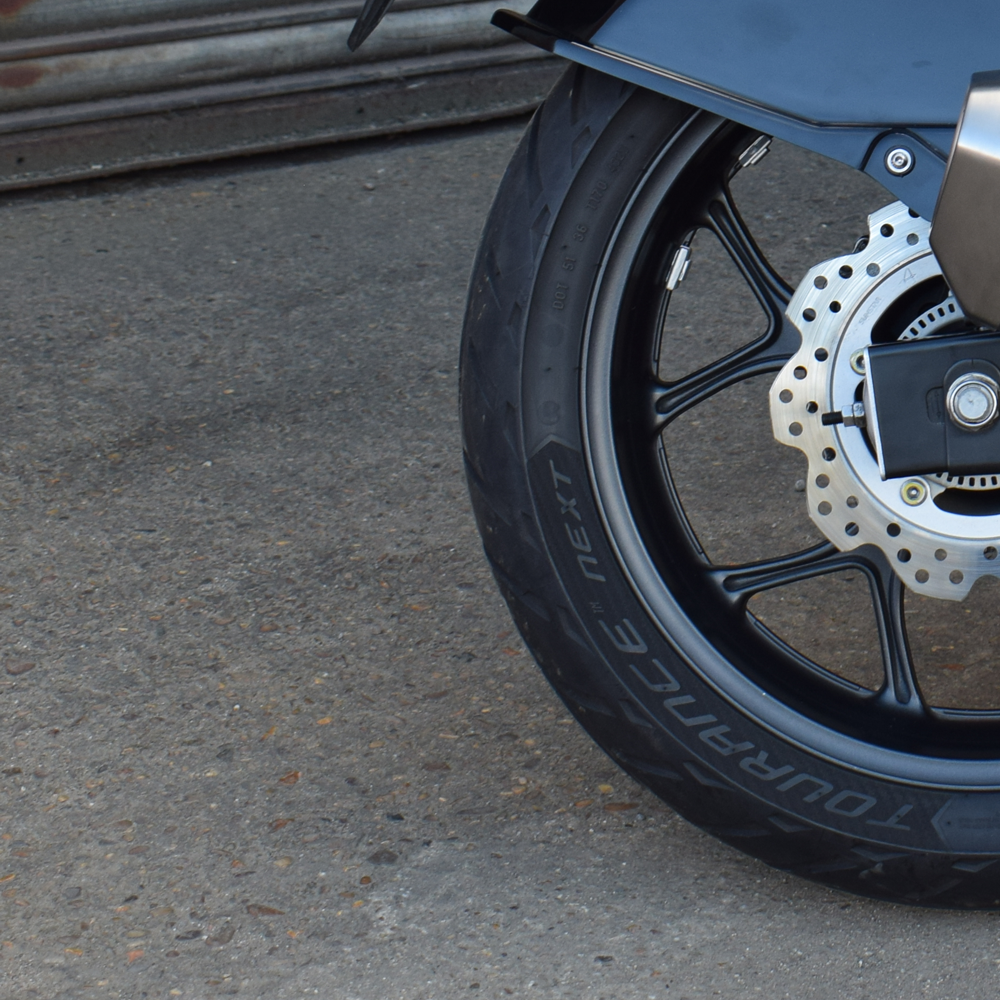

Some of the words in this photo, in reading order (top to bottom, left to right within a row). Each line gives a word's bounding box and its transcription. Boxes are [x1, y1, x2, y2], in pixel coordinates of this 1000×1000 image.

[552, 283, 570, 310] DOT
[573, 224, 589, 242] 36
[550, 460, 606, 583] NEXT
[598, 618, 915, 832] TOURANCE
